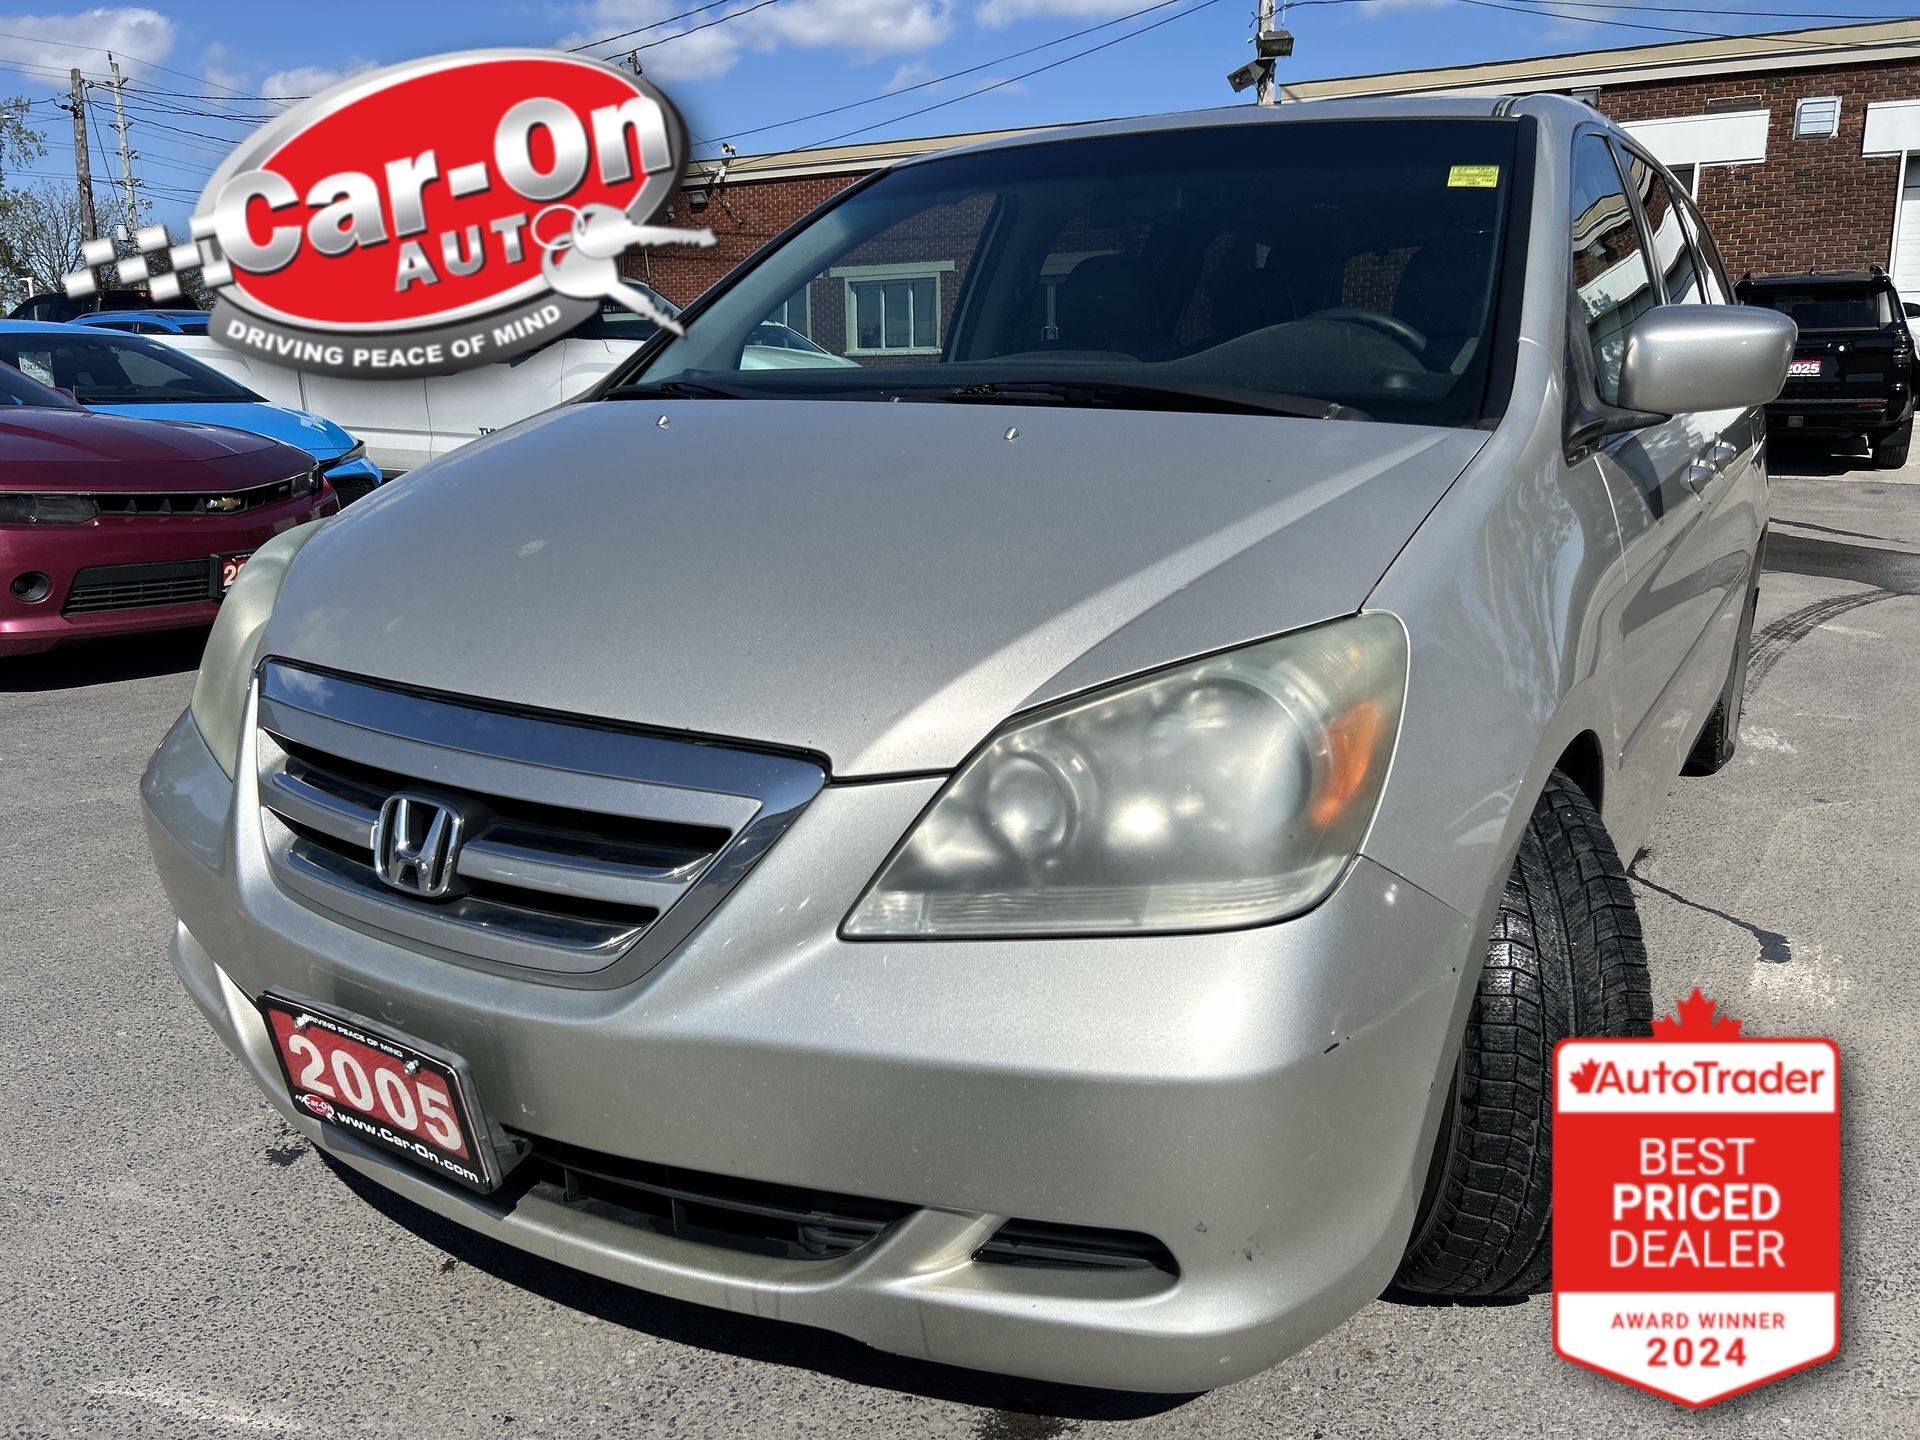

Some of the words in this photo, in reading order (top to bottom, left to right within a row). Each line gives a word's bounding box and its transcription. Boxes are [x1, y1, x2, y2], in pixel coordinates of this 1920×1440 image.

[337, 1026, 366, 1042] PEACE
[367, 1037, 379, 1047] OF
[380, 1043, 404, 1057] MIND
[289, 1035, 462, 1150] 2005
[337, 1112, 479, 1183] www.Car-On.com
